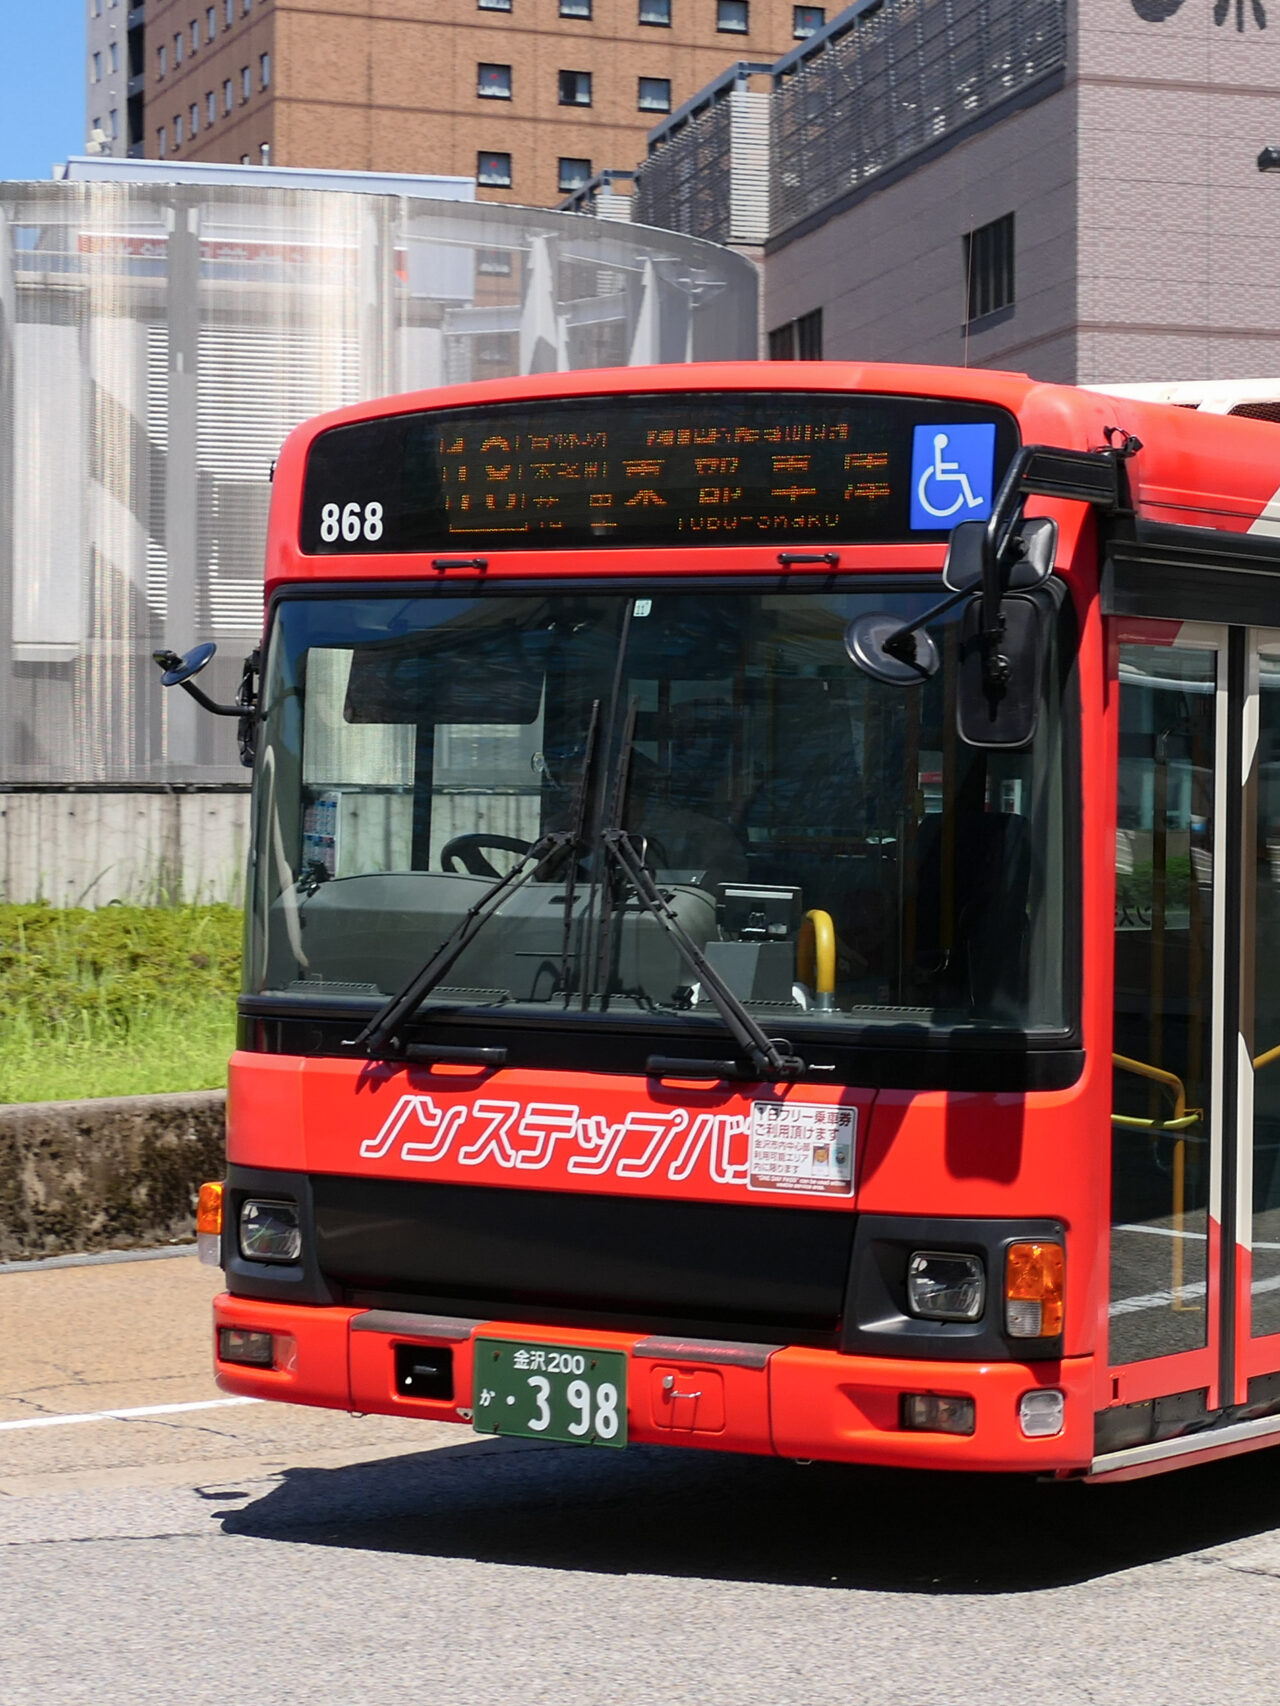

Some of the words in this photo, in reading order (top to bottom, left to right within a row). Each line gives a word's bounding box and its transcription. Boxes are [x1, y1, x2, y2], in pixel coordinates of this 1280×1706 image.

[320, 501, 384, 543] 868
[359, 1094, 752, 1184] ノンステップバ
[755, 1123, 840, 1141] ご利用頂けます
